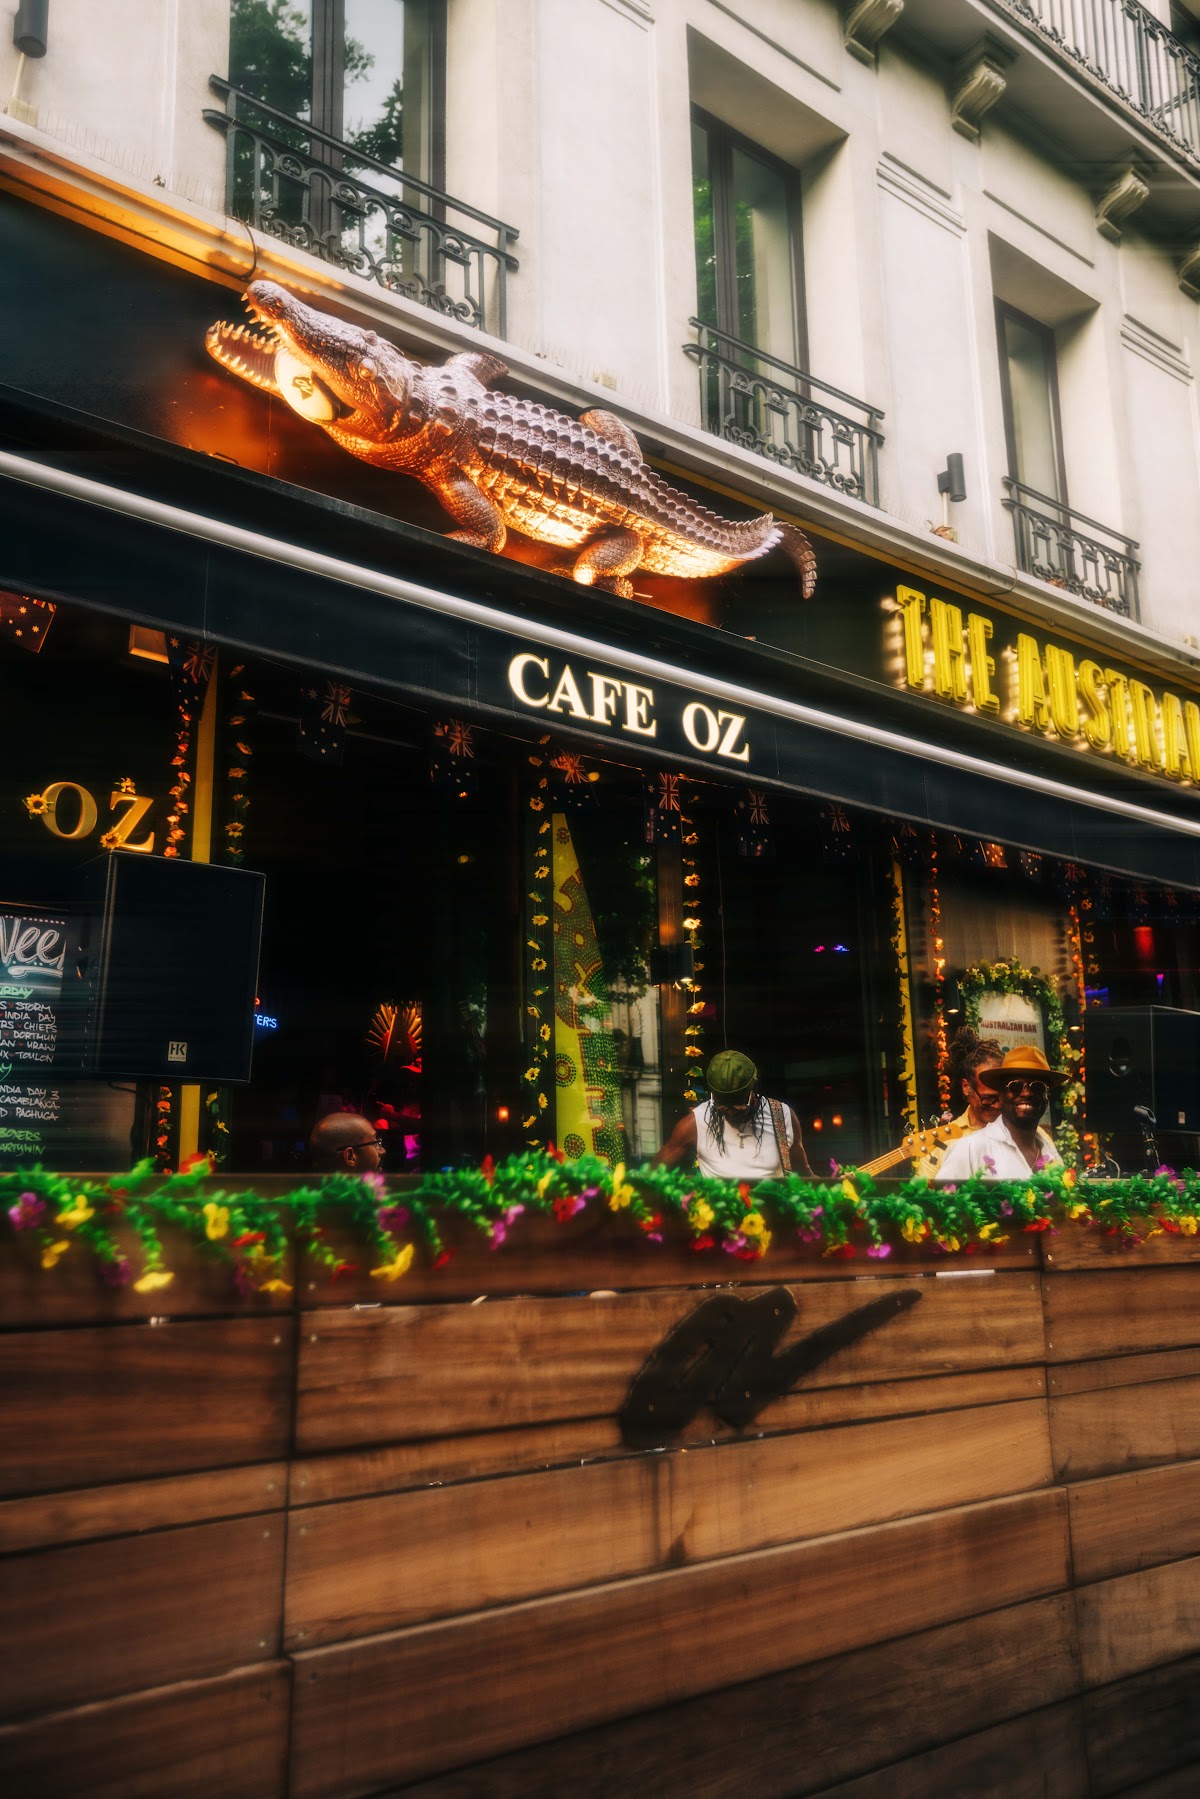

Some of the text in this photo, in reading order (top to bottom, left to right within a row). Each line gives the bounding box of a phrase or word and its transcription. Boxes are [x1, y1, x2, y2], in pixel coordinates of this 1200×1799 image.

[896, 584, 1001, 716] THE
[508, 652, 750, 763] CAFE OZ
[41, 781, 155, 853] OZ
[15, 1002, 51, 1013] STORM
[5, 1010, 56, 1026] INDIA DAY
[24, 1022, 58, 1033] CHIEFS
[981, 1020, 1037, 1034] AUSTRALIAN BAR
[170, 1043, 186, 1055] HK
[15, 1051, 54, 1063] TOULON
[26, 1086, 47, 1100] DAY
[50, 1090, 60, 1100] 3
[0, 1095, 60, 1110] CASABLANCA
